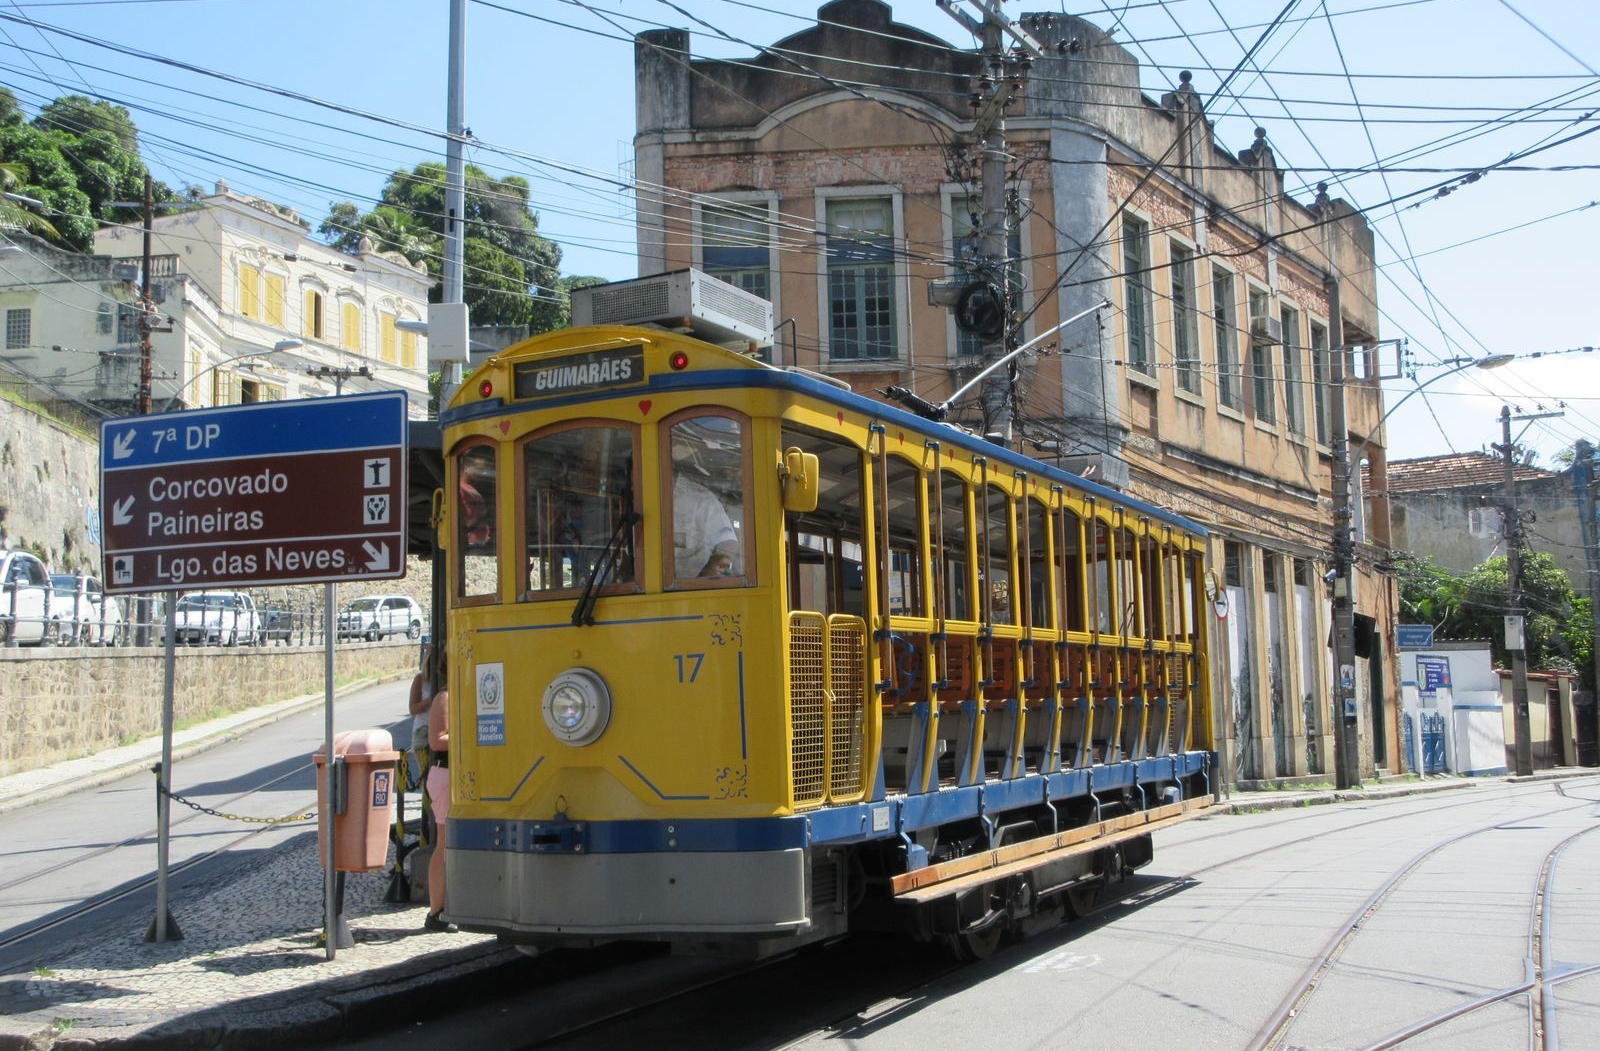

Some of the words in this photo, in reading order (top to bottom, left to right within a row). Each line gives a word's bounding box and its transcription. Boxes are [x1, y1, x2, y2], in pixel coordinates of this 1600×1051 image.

[535, 357, 631, 390] GUIMARÃES
[186, 423, 220, 451] DP
[149, 468, 288, 502] Corcovado
[148, 507, 264, 536] Paineiras
[157, 554, 208, 583] Lgo.
[212, 550, 258, 575] das
[265, 546, 346, 571] Neves
[673, 653, 705, 683] 17
[478, 725, 489, 733] Rio
[489, 724, 498, 733] de
[478, 733, 503, 741] Janeiro
